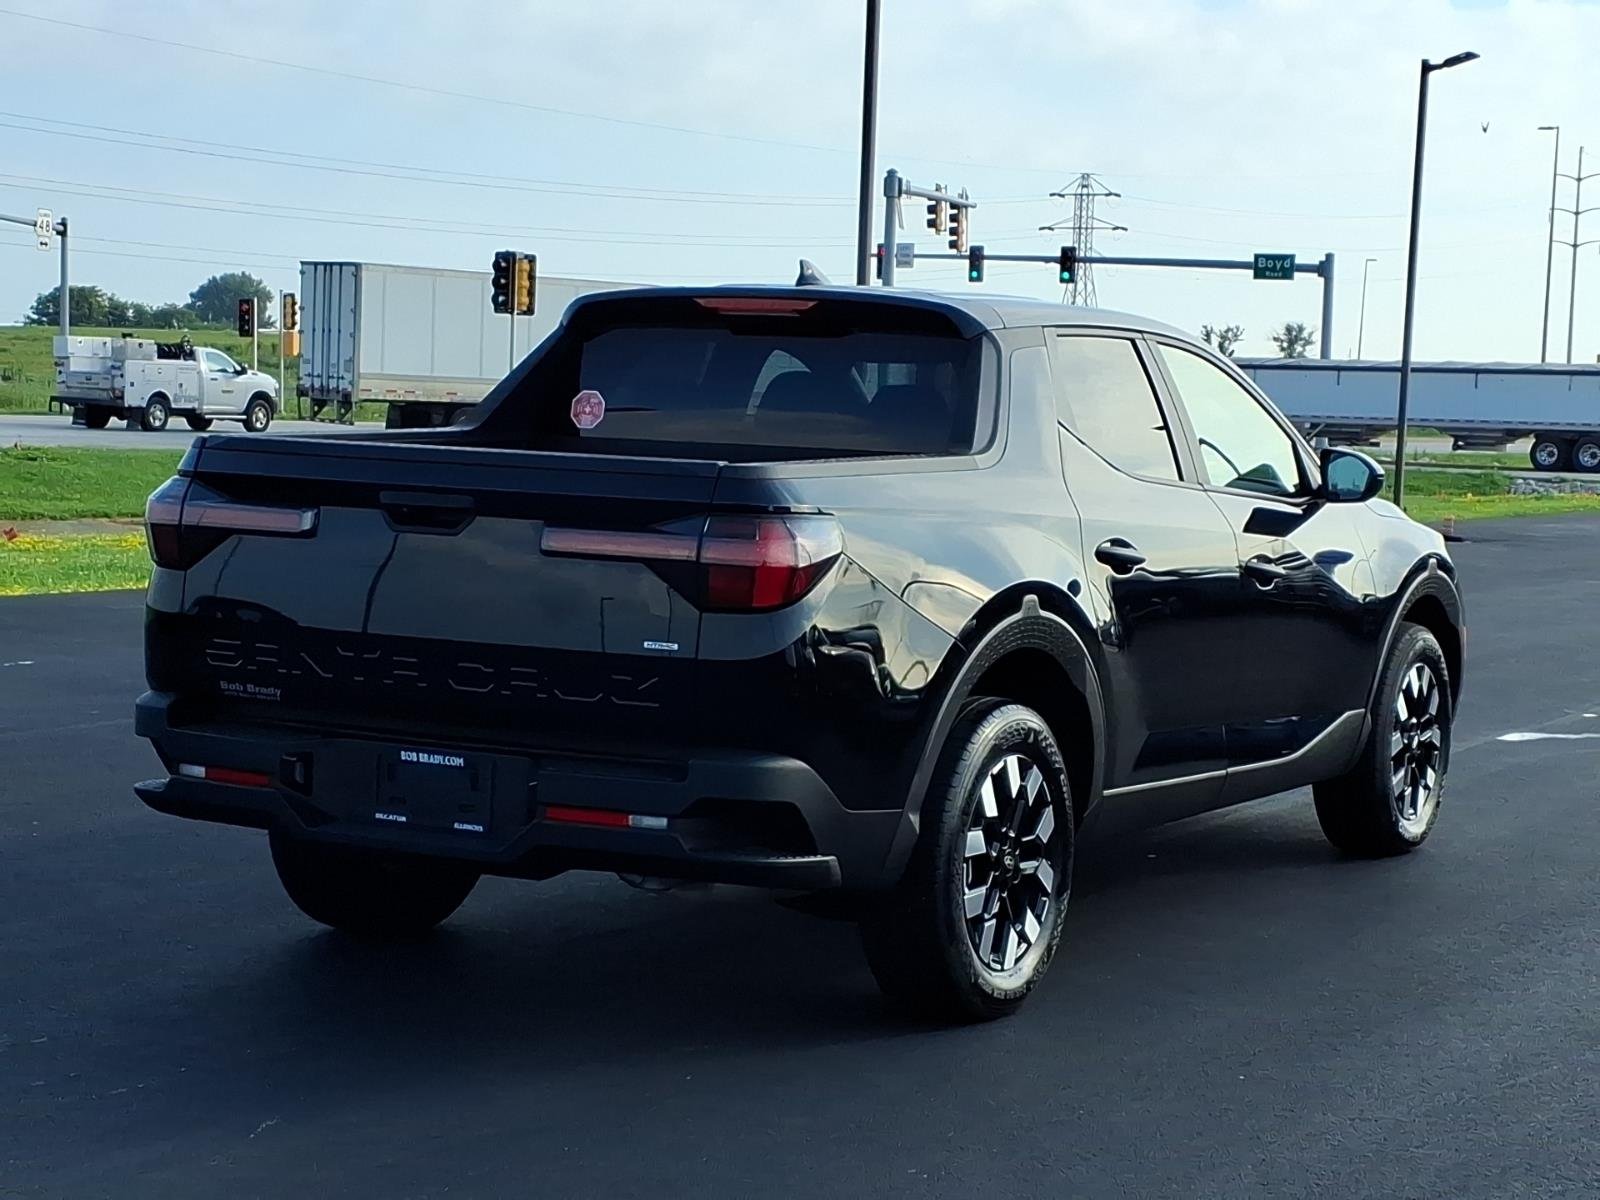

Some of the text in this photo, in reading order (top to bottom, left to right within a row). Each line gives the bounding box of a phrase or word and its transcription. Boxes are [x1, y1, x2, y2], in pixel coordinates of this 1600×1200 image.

[39, 220, 50, 232] 48
[1258, 257, 1291, 270] Boyd
[206, 638, 660, 707] SANTA CRUZ
[219, 680, 243, 691] Bob
[246, 683, 281, 697] Brady
[400, 750, 464, 767] BOB BRADY.COM
[375, 812, 406, 822] DECATUR
